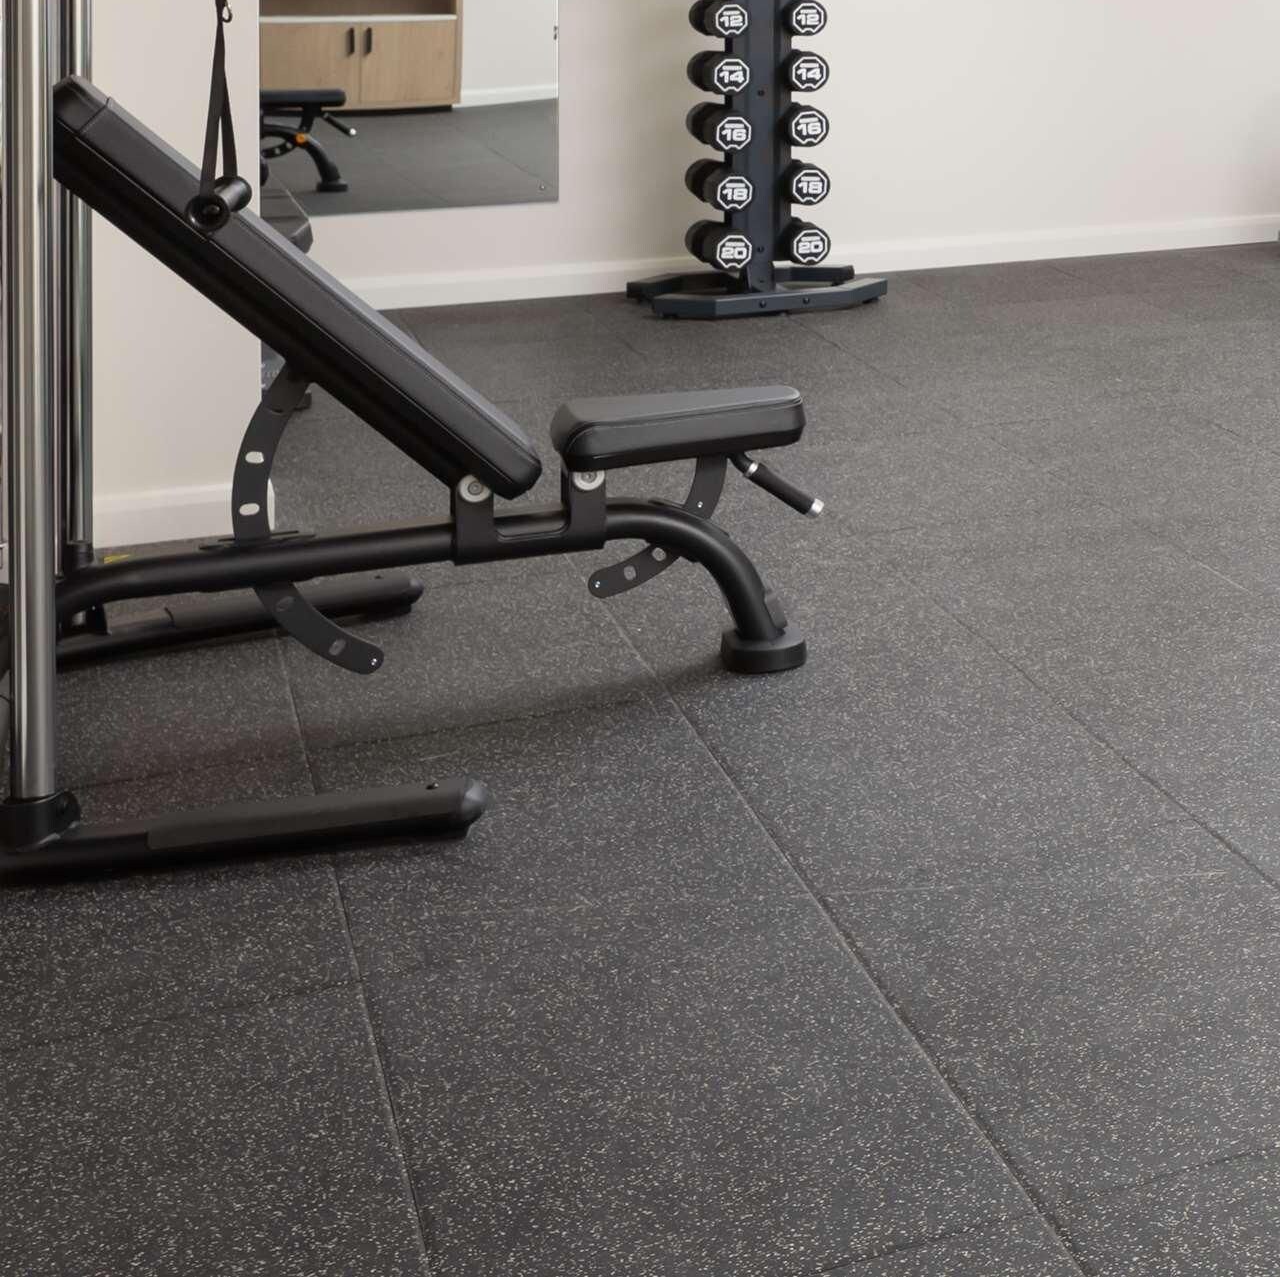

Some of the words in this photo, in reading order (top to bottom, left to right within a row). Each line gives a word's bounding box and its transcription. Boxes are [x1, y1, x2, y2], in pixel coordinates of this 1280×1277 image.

[720, 15, 743, 27] 12
[796, 13, 820, 25] 12
[719, 70, 745, 83] 14
[796, 67, 821, 80] 14
[721, 128, 747, 141] 16
[796, 122, 822, 136] 16
[722, 187, 748, 201] 18
[798, 181, 823, 194] 18
[721, 246, 748, 259] 20
[798, 241, 823, 254] 20
